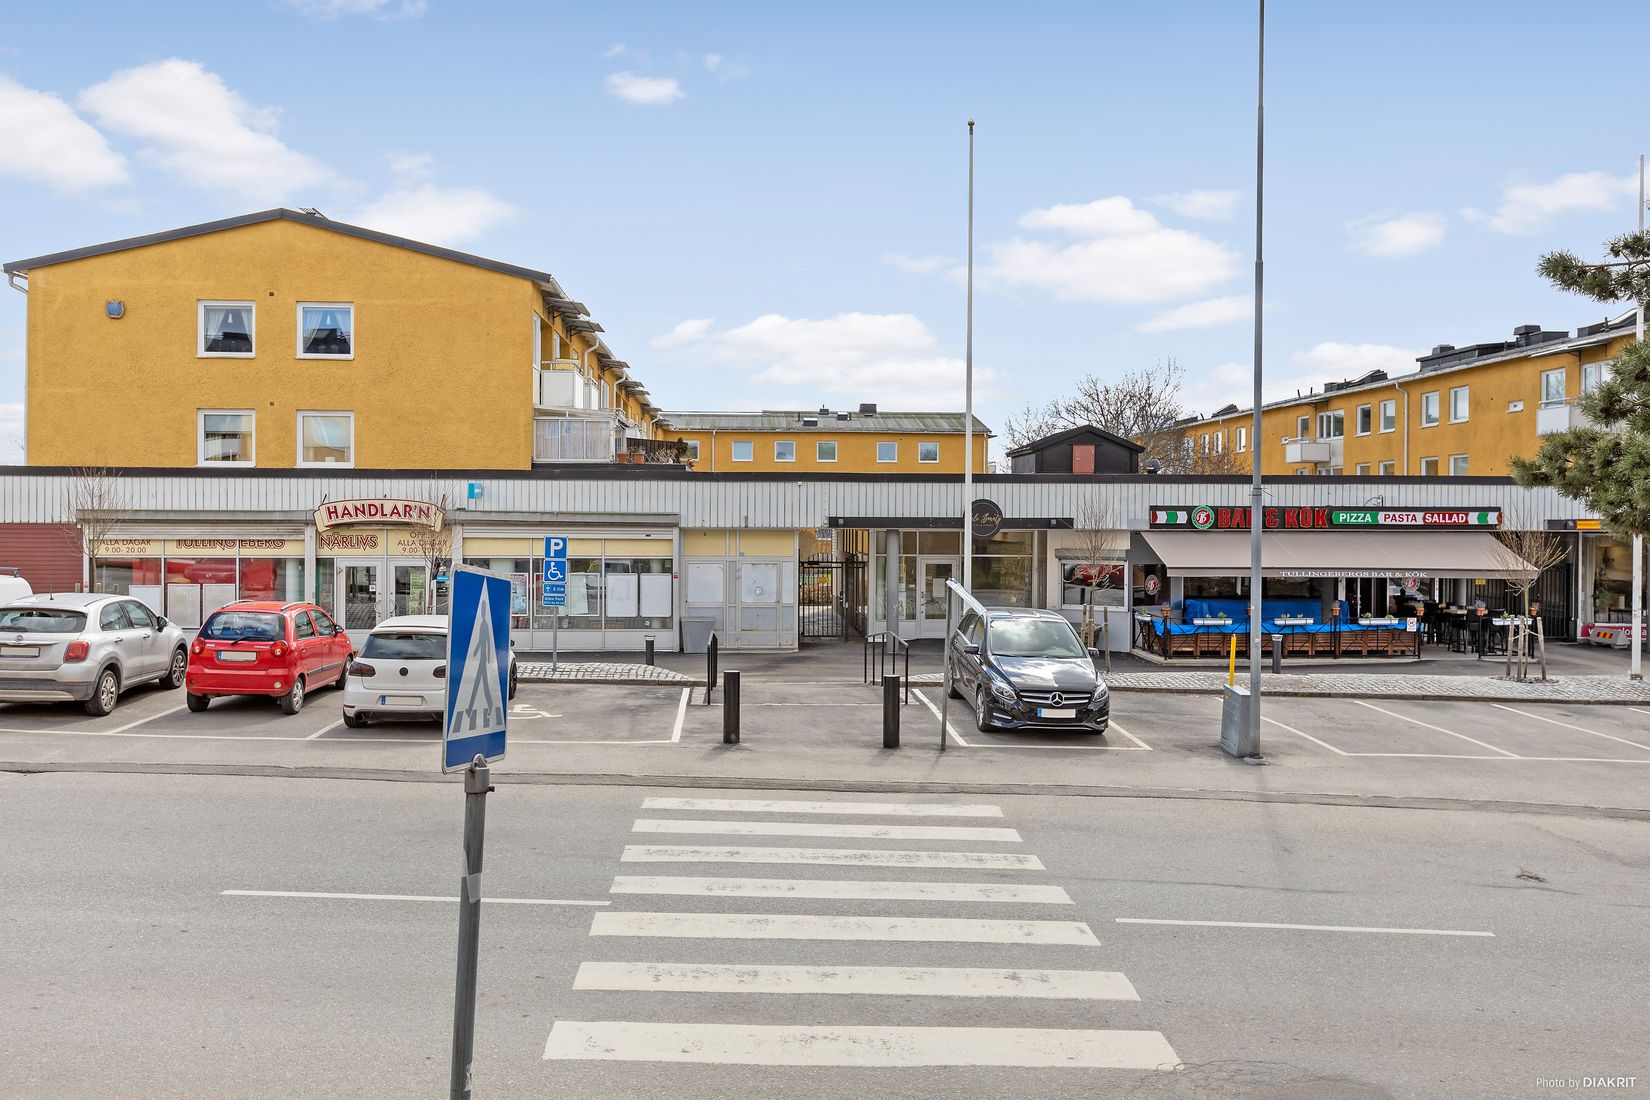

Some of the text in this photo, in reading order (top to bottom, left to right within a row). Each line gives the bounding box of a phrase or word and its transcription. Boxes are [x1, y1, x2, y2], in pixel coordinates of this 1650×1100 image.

[326, 503, 430, 520] HANDLAR'N
[1265, 507, 1280, 528] &
[1285, 505, 1328, 528] KÖK
[1339, 513, 1466, 523] PIZZA PASTA SALLAD
[320, 531, 378, 551] NÄRLIVS
[397, 539, 416, 547] ALLA
[550, 538, 564, 557] P
